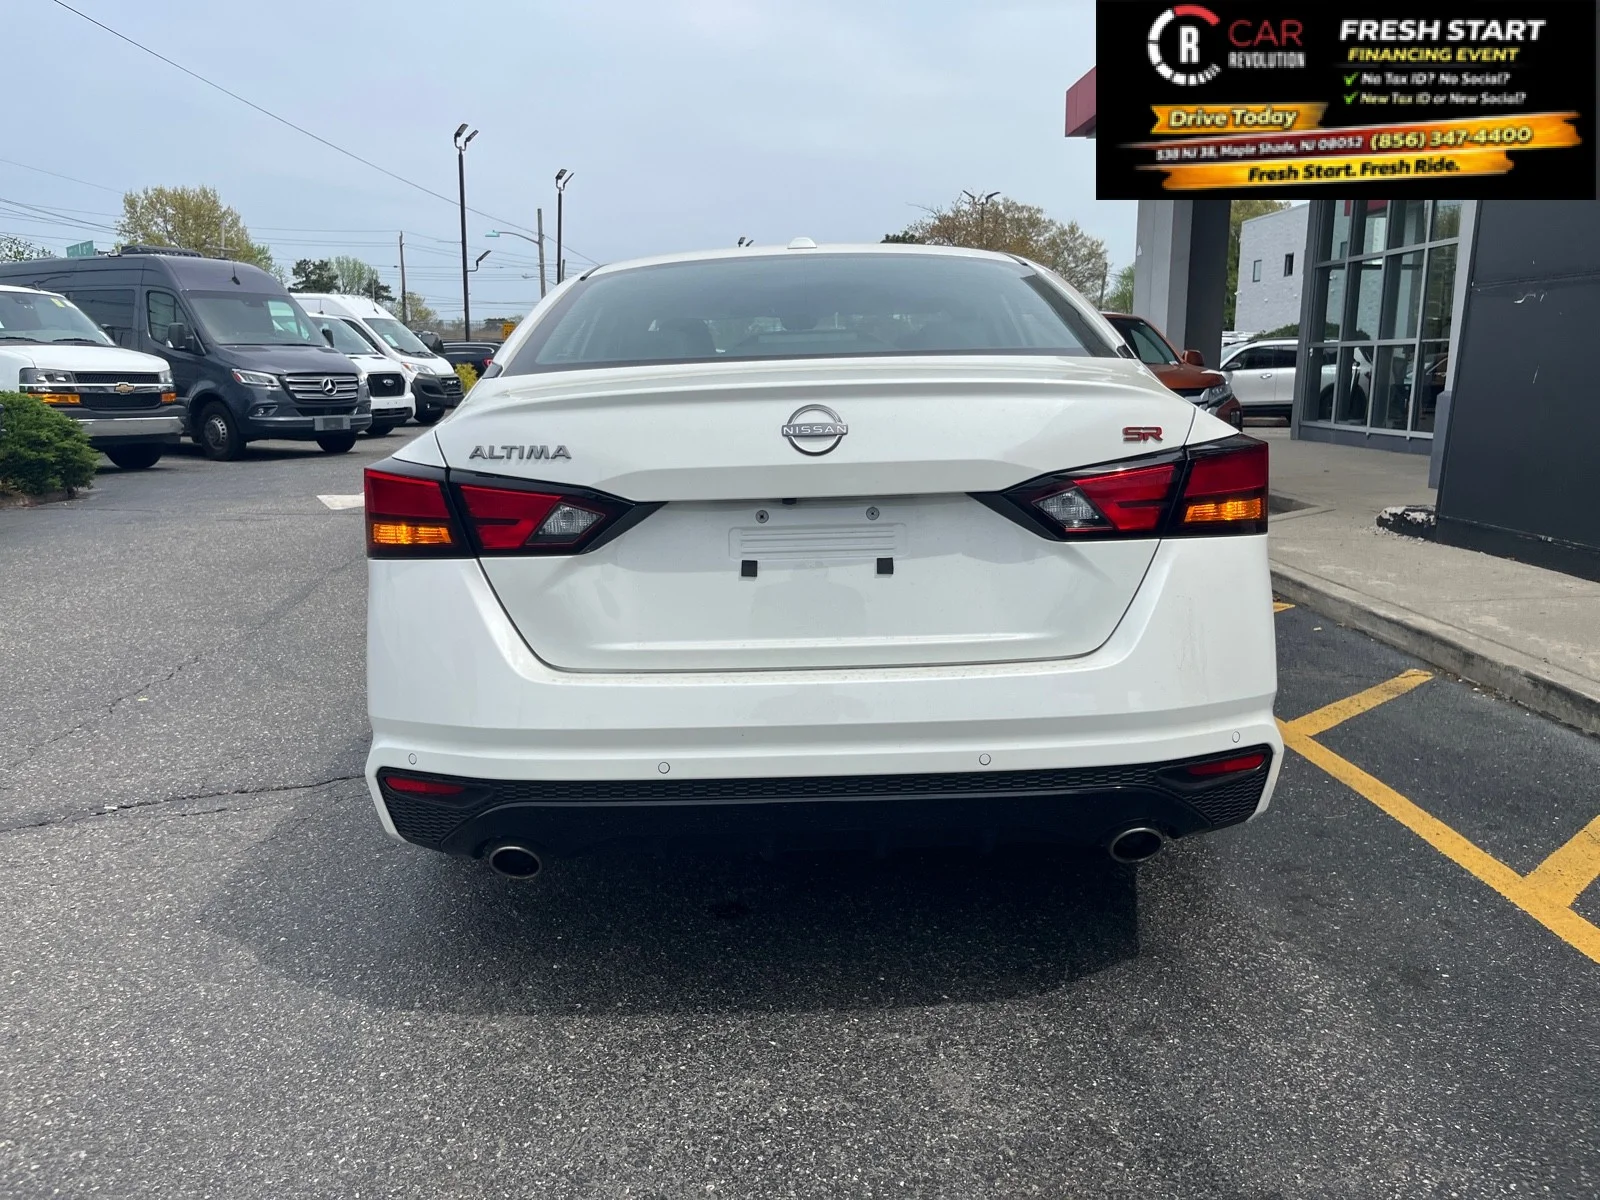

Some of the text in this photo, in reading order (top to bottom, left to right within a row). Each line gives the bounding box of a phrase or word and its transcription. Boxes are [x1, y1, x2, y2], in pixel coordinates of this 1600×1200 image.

[783, 425, 847, 435] NISSAN
[1122, 426, 1164, 442] SR
[469, 445, 572, 460] ALTIMA
